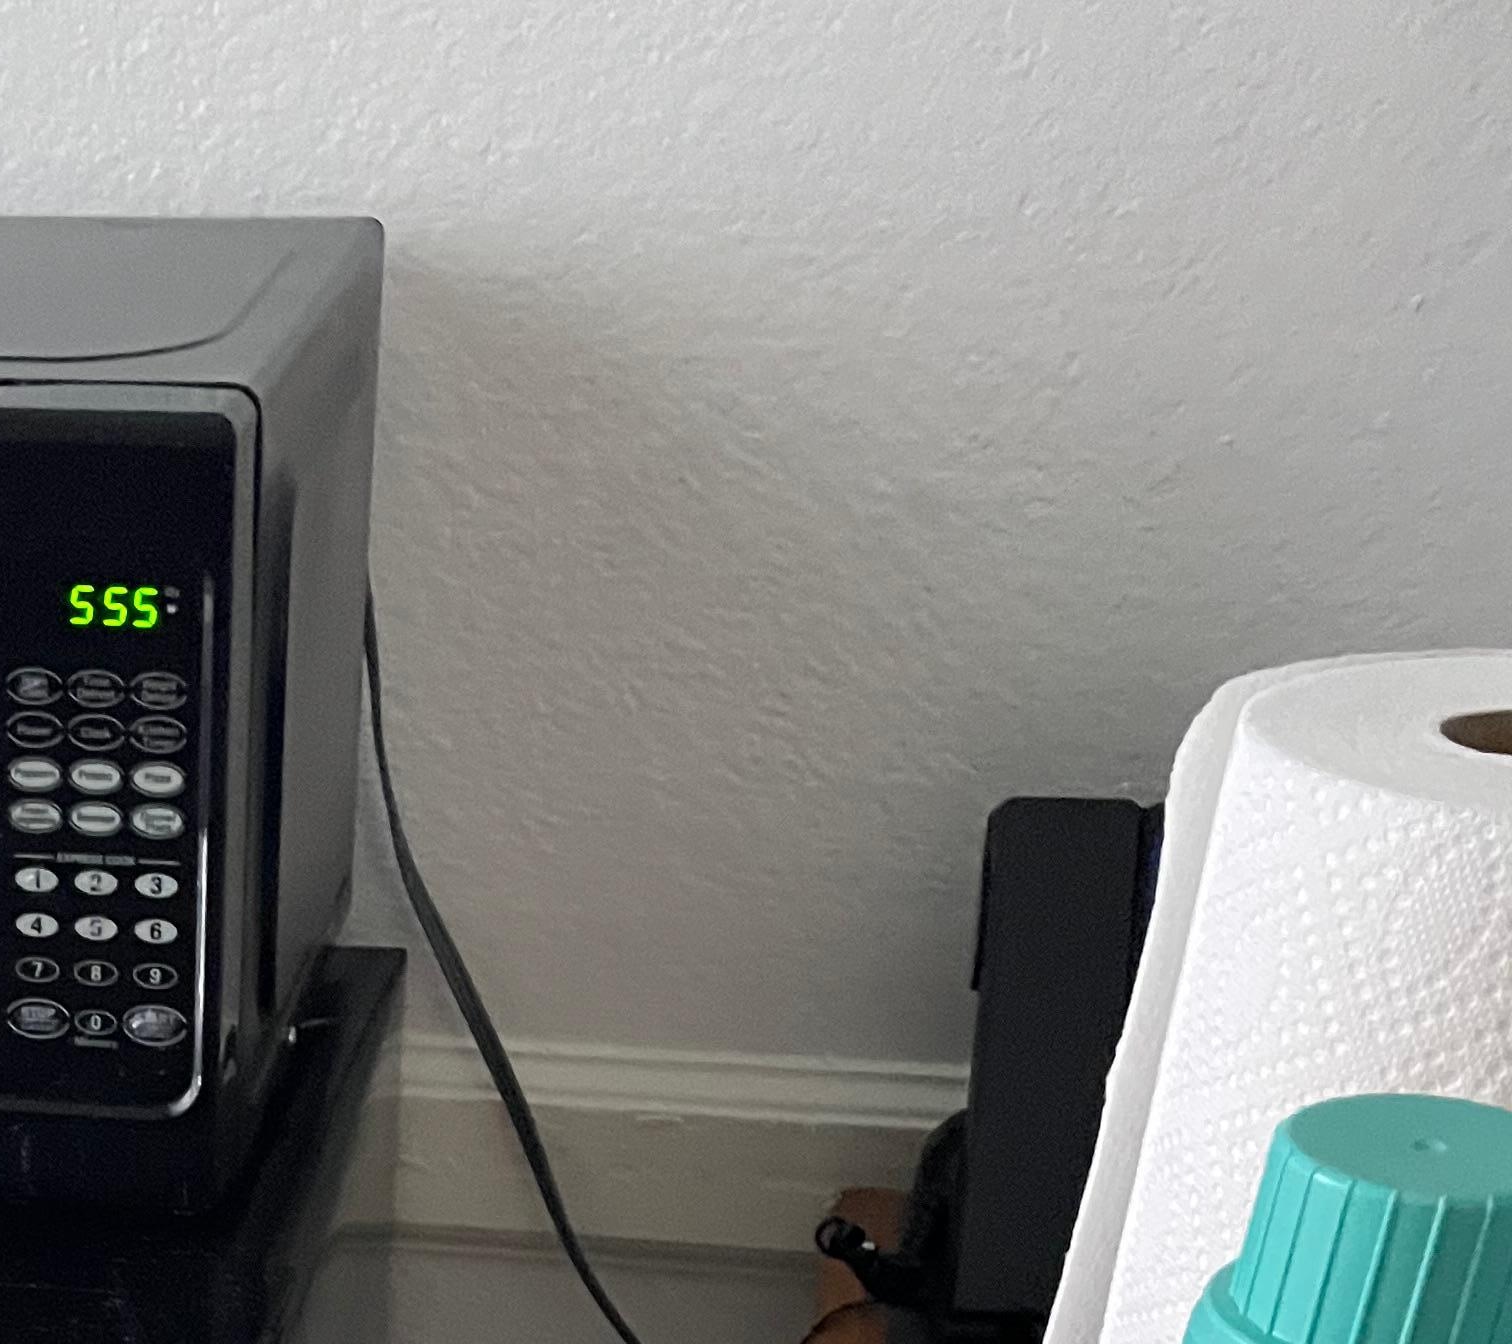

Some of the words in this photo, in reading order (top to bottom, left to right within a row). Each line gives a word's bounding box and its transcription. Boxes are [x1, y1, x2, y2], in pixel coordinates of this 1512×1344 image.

[69, 584, 158, 628] 555
[90, 873, 103, 893] 2
[150, 875, 163, 895] 3
[31, 916, 43, 934] 4
[90, 919, 102, 937] 5
[150, 922, 162, 940] 6
[32, 961, 43, 977] 7
[91, 965, 102, 982] 8
[149, 968, 162, 985] 9
[90, 1014, 101, 1030] 0
